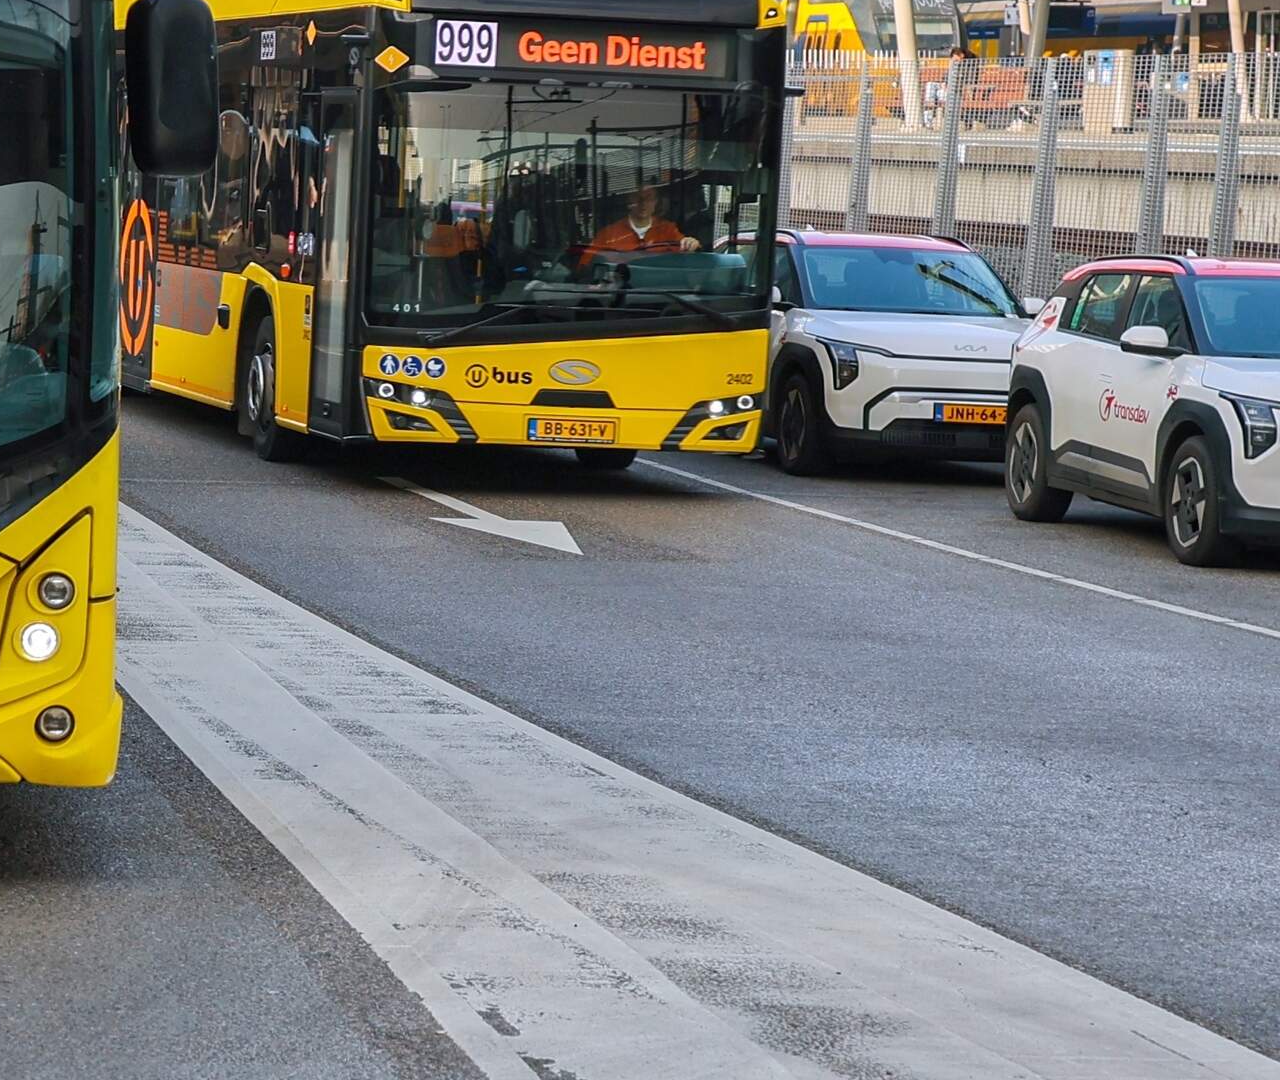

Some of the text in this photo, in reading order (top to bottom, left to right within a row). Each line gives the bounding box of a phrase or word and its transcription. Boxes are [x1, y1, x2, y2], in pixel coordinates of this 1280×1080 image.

[439, 22, 706, 70] 999 Geen Dienst
[392, 303, 420, 313] 401
[726, 373, 753, 385] 2402
[1113, 403, 1150, 424] transdev
[543, 422, 608, 437] BB-631-V
